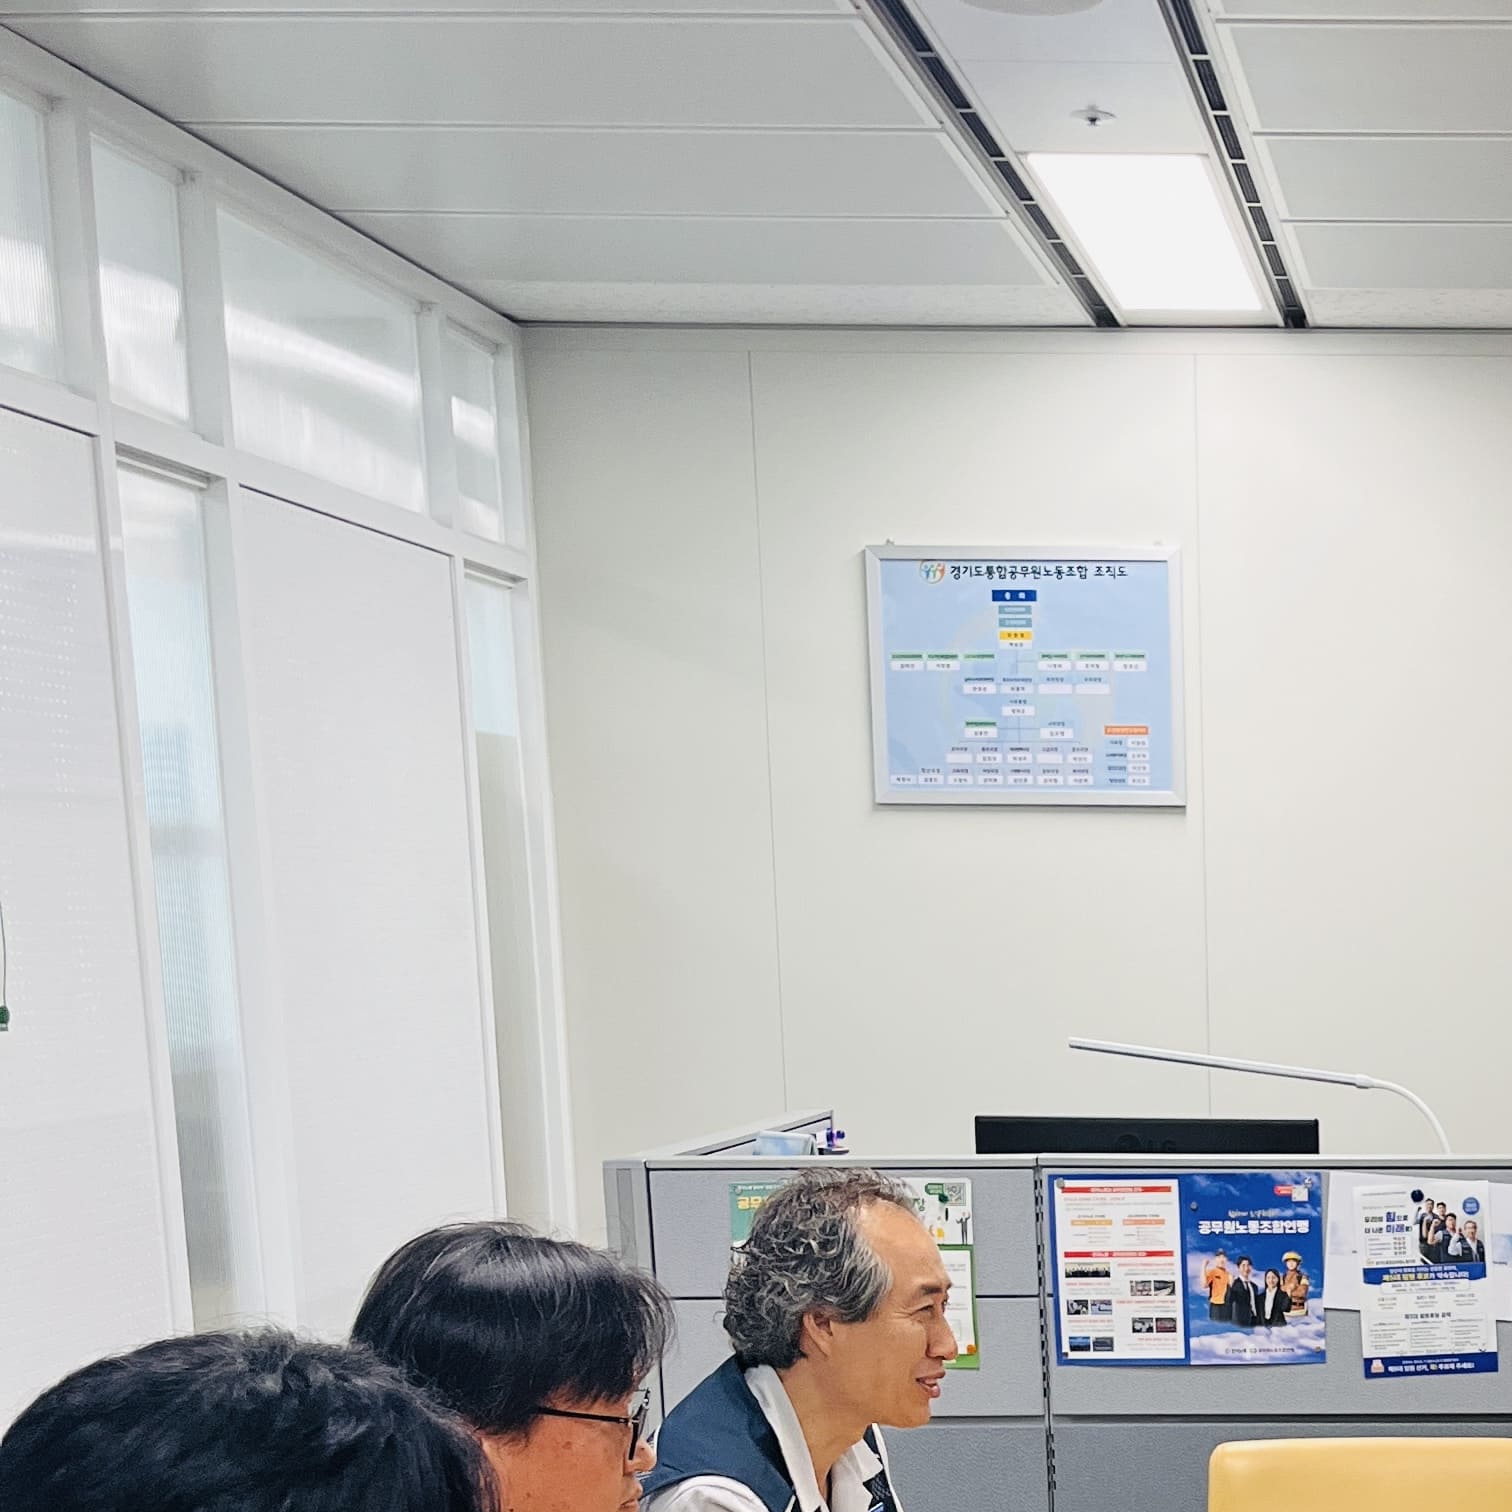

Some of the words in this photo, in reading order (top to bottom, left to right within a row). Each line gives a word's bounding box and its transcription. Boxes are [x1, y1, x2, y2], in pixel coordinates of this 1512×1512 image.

[950, 565, 1088, 580] 경기도통합공무원노동조합
[1094, 565, 1129, 579] 조직도
[1198, 1220, 1310, 1234] 공무원노동조합연맹
